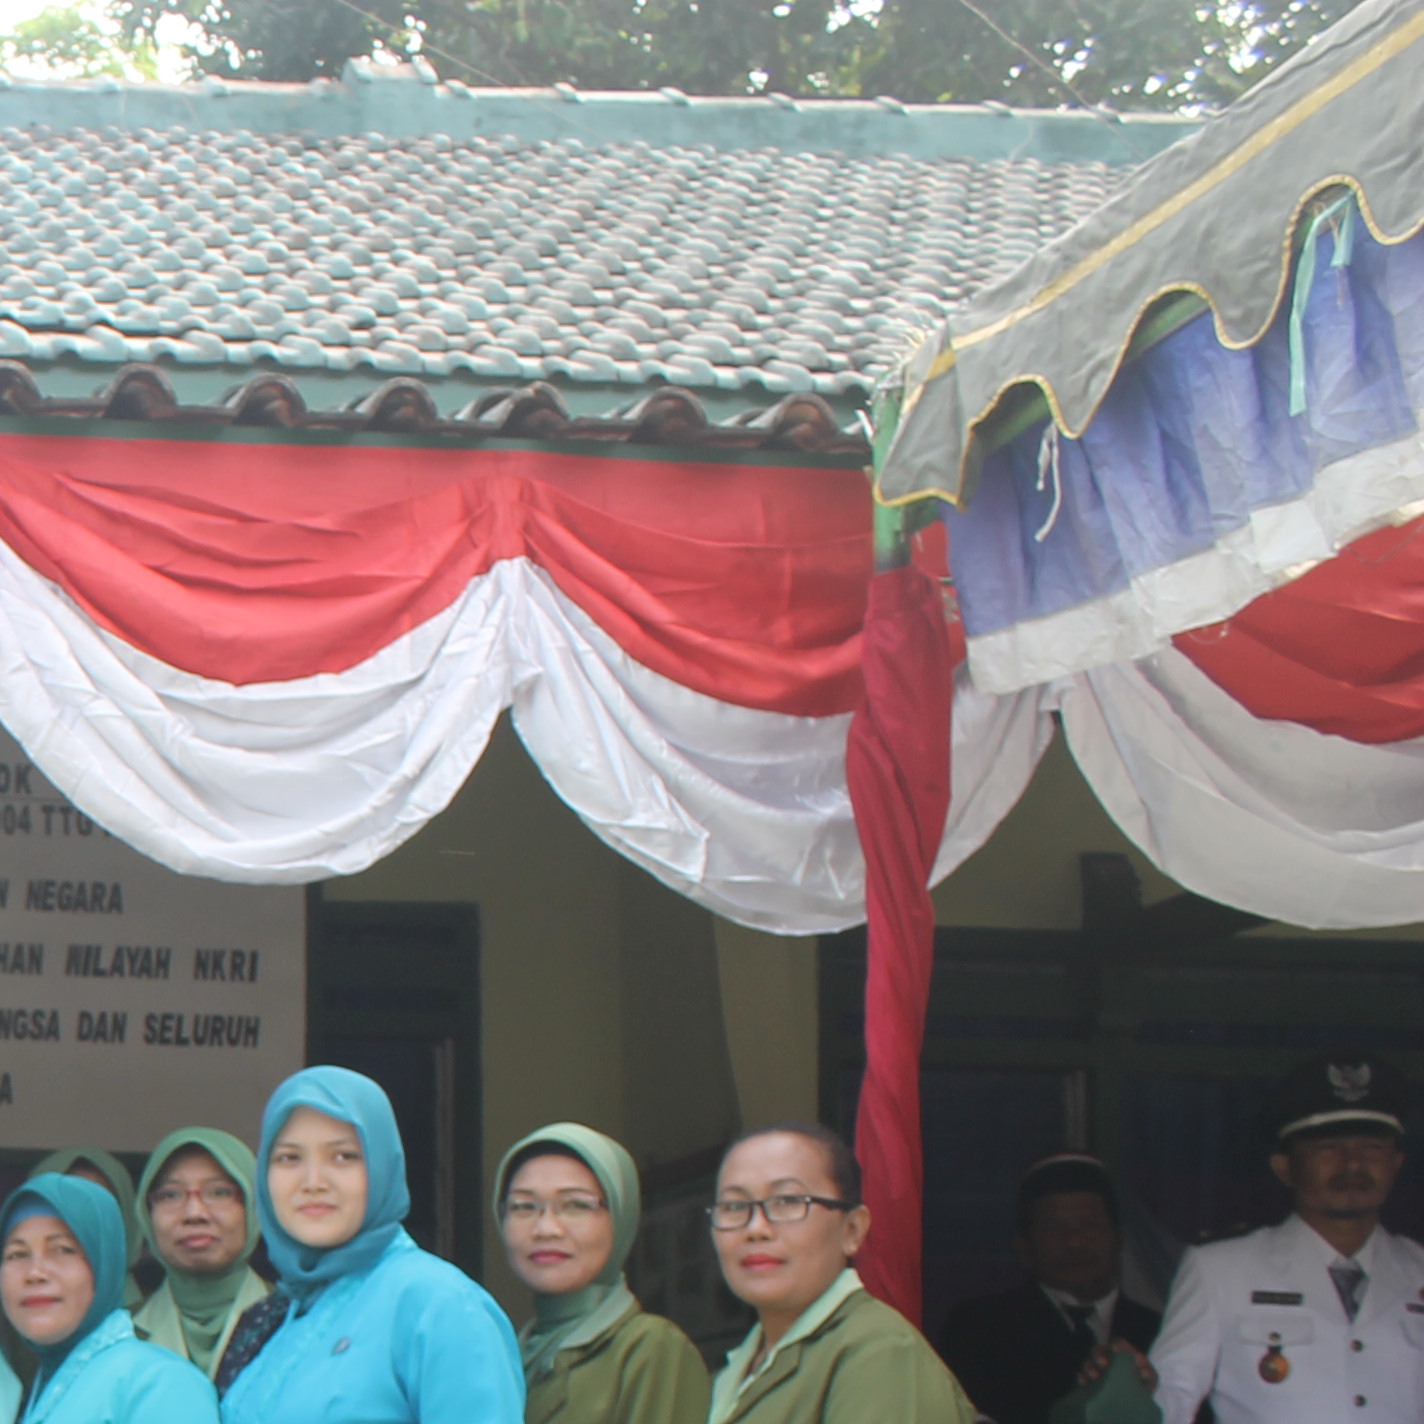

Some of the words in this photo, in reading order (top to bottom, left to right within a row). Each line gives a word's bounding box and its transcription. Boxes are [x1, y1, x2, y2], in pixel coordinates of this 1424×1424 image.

[25, 879, 123, 914] NEGARA
[64, 943, 171, 980] WILAYAH
[193, 949, 259, 983] NKRI
[76, 1010, 127, 1044] DAN
[143, 1012, 260, 1048] SELURUH
